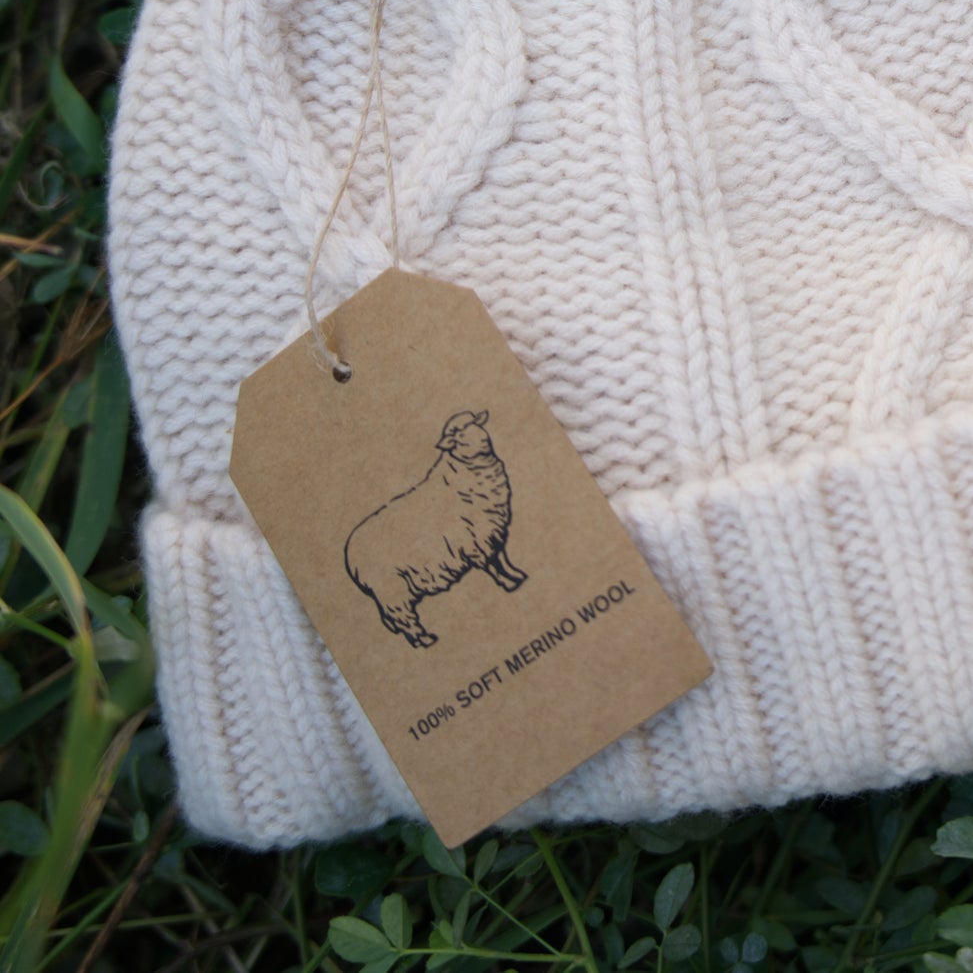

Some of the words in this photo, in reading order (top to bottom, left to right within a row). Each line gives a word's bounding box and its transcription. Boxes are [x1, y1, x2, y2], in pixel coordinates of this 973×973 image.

[408, 703, 456, 741] 100%
[456, 667, 503, 709] SOFT
[504, 618, 577, 675] MERINO
[576, 580, 636, 624] WOOL
